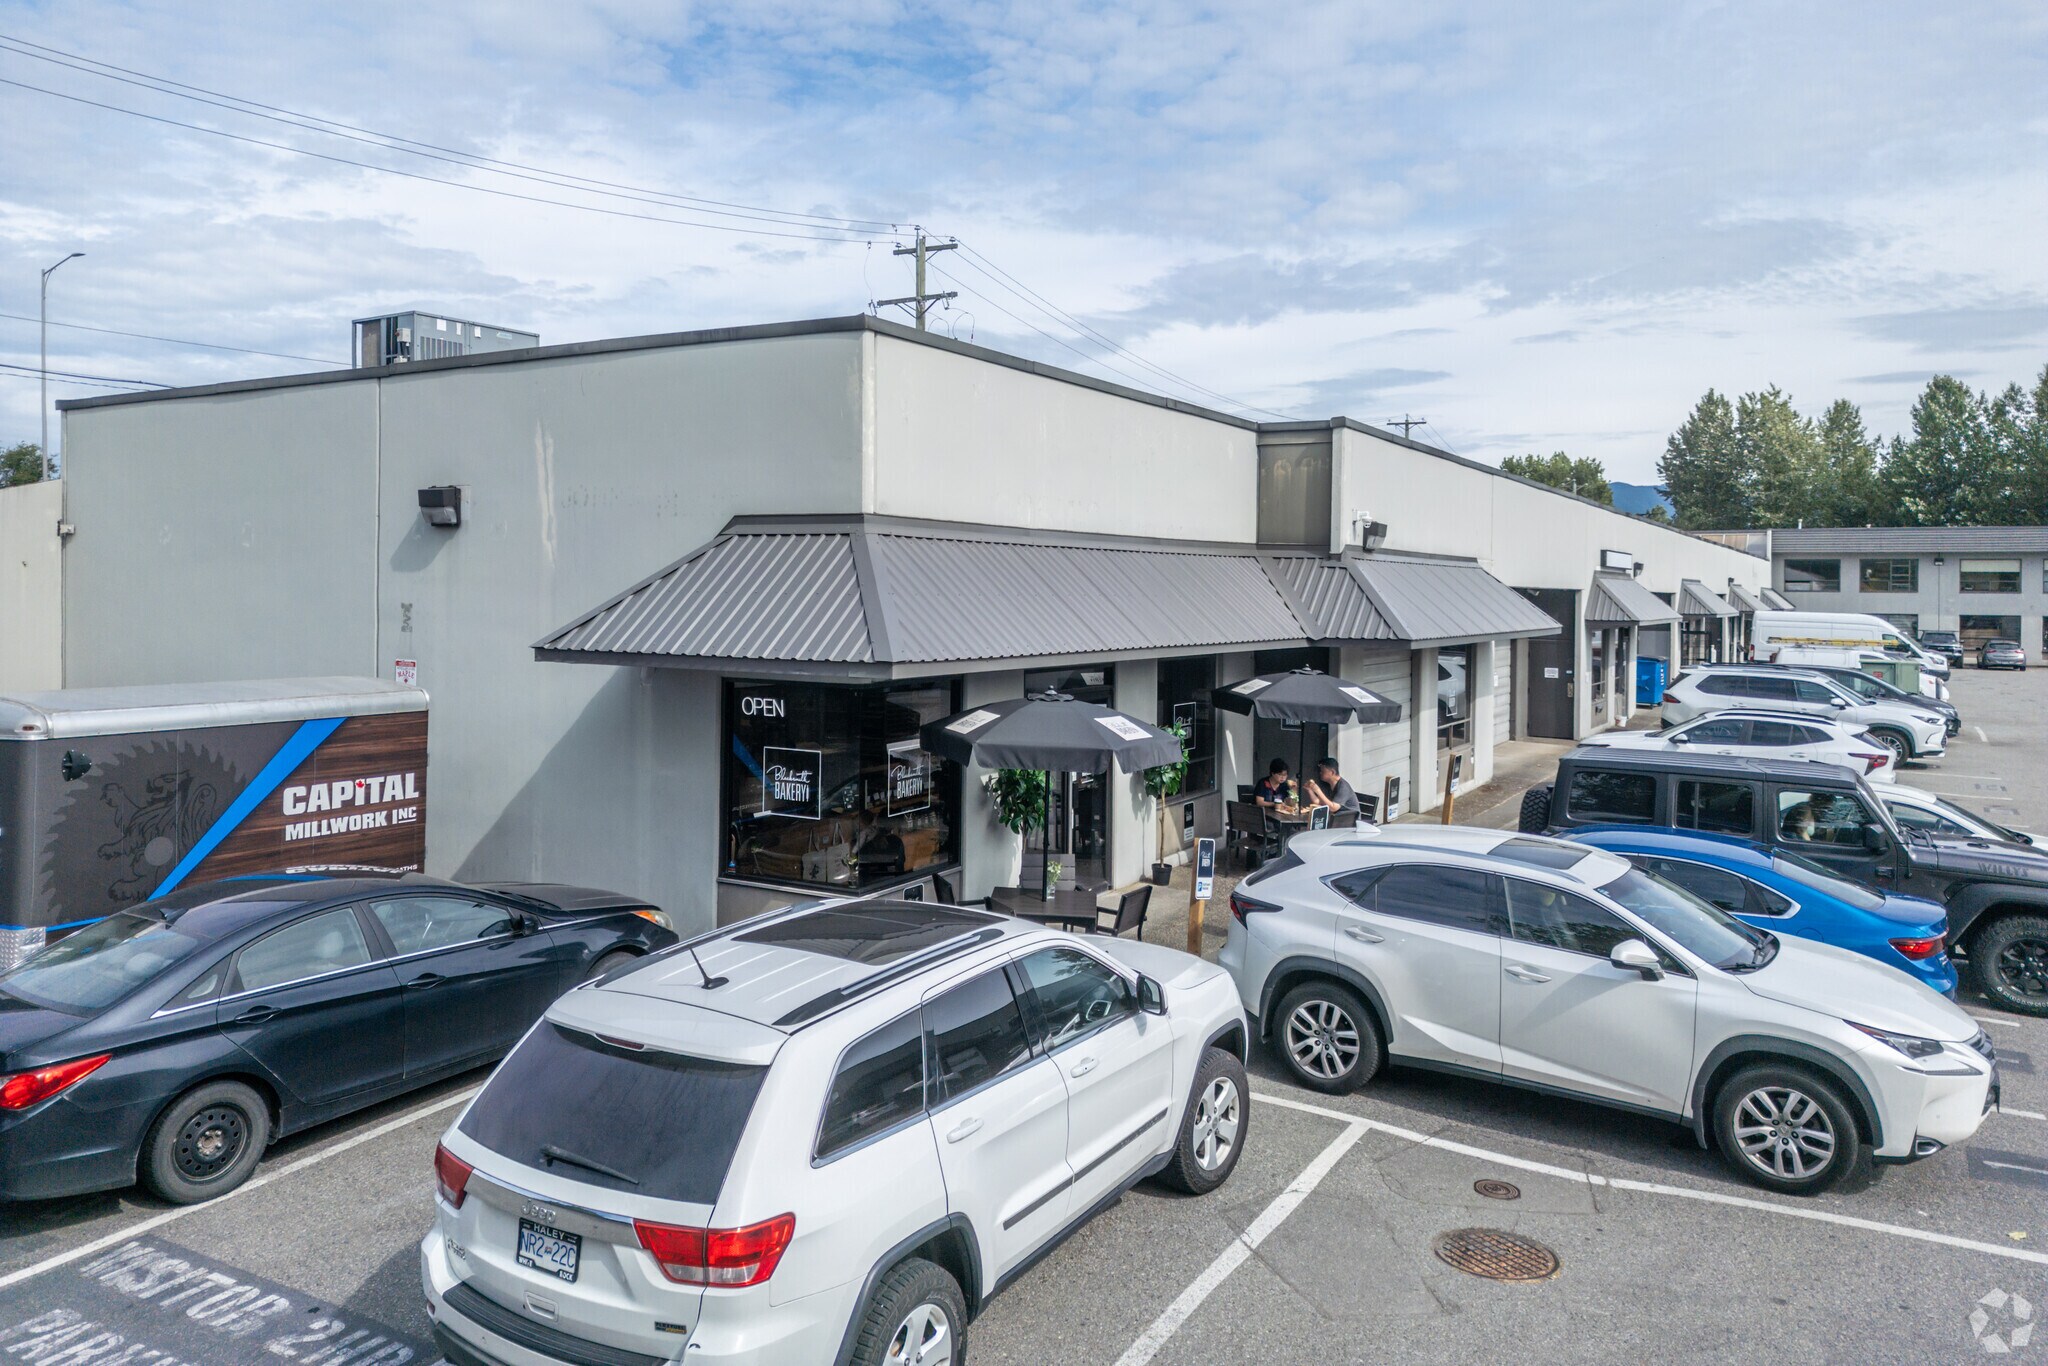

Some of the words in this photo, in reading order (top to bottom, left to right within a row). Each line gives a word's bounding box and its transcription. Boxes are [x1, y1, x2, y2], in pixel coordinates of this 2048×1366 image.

[741, 697, 784, 717] OPEN
[283, 773, 419, 816] CAPITAL
[774, 781, 807, 802] BAKERY
[285, 810, 388, 842] MILLWORK
[392, 806, 417, 825] INC
[1978, 863, 2029, 877] WILLYS
[533, 1223, 565, 1240] HALEY
[79, 1241, 290, 1337] VISITOR
